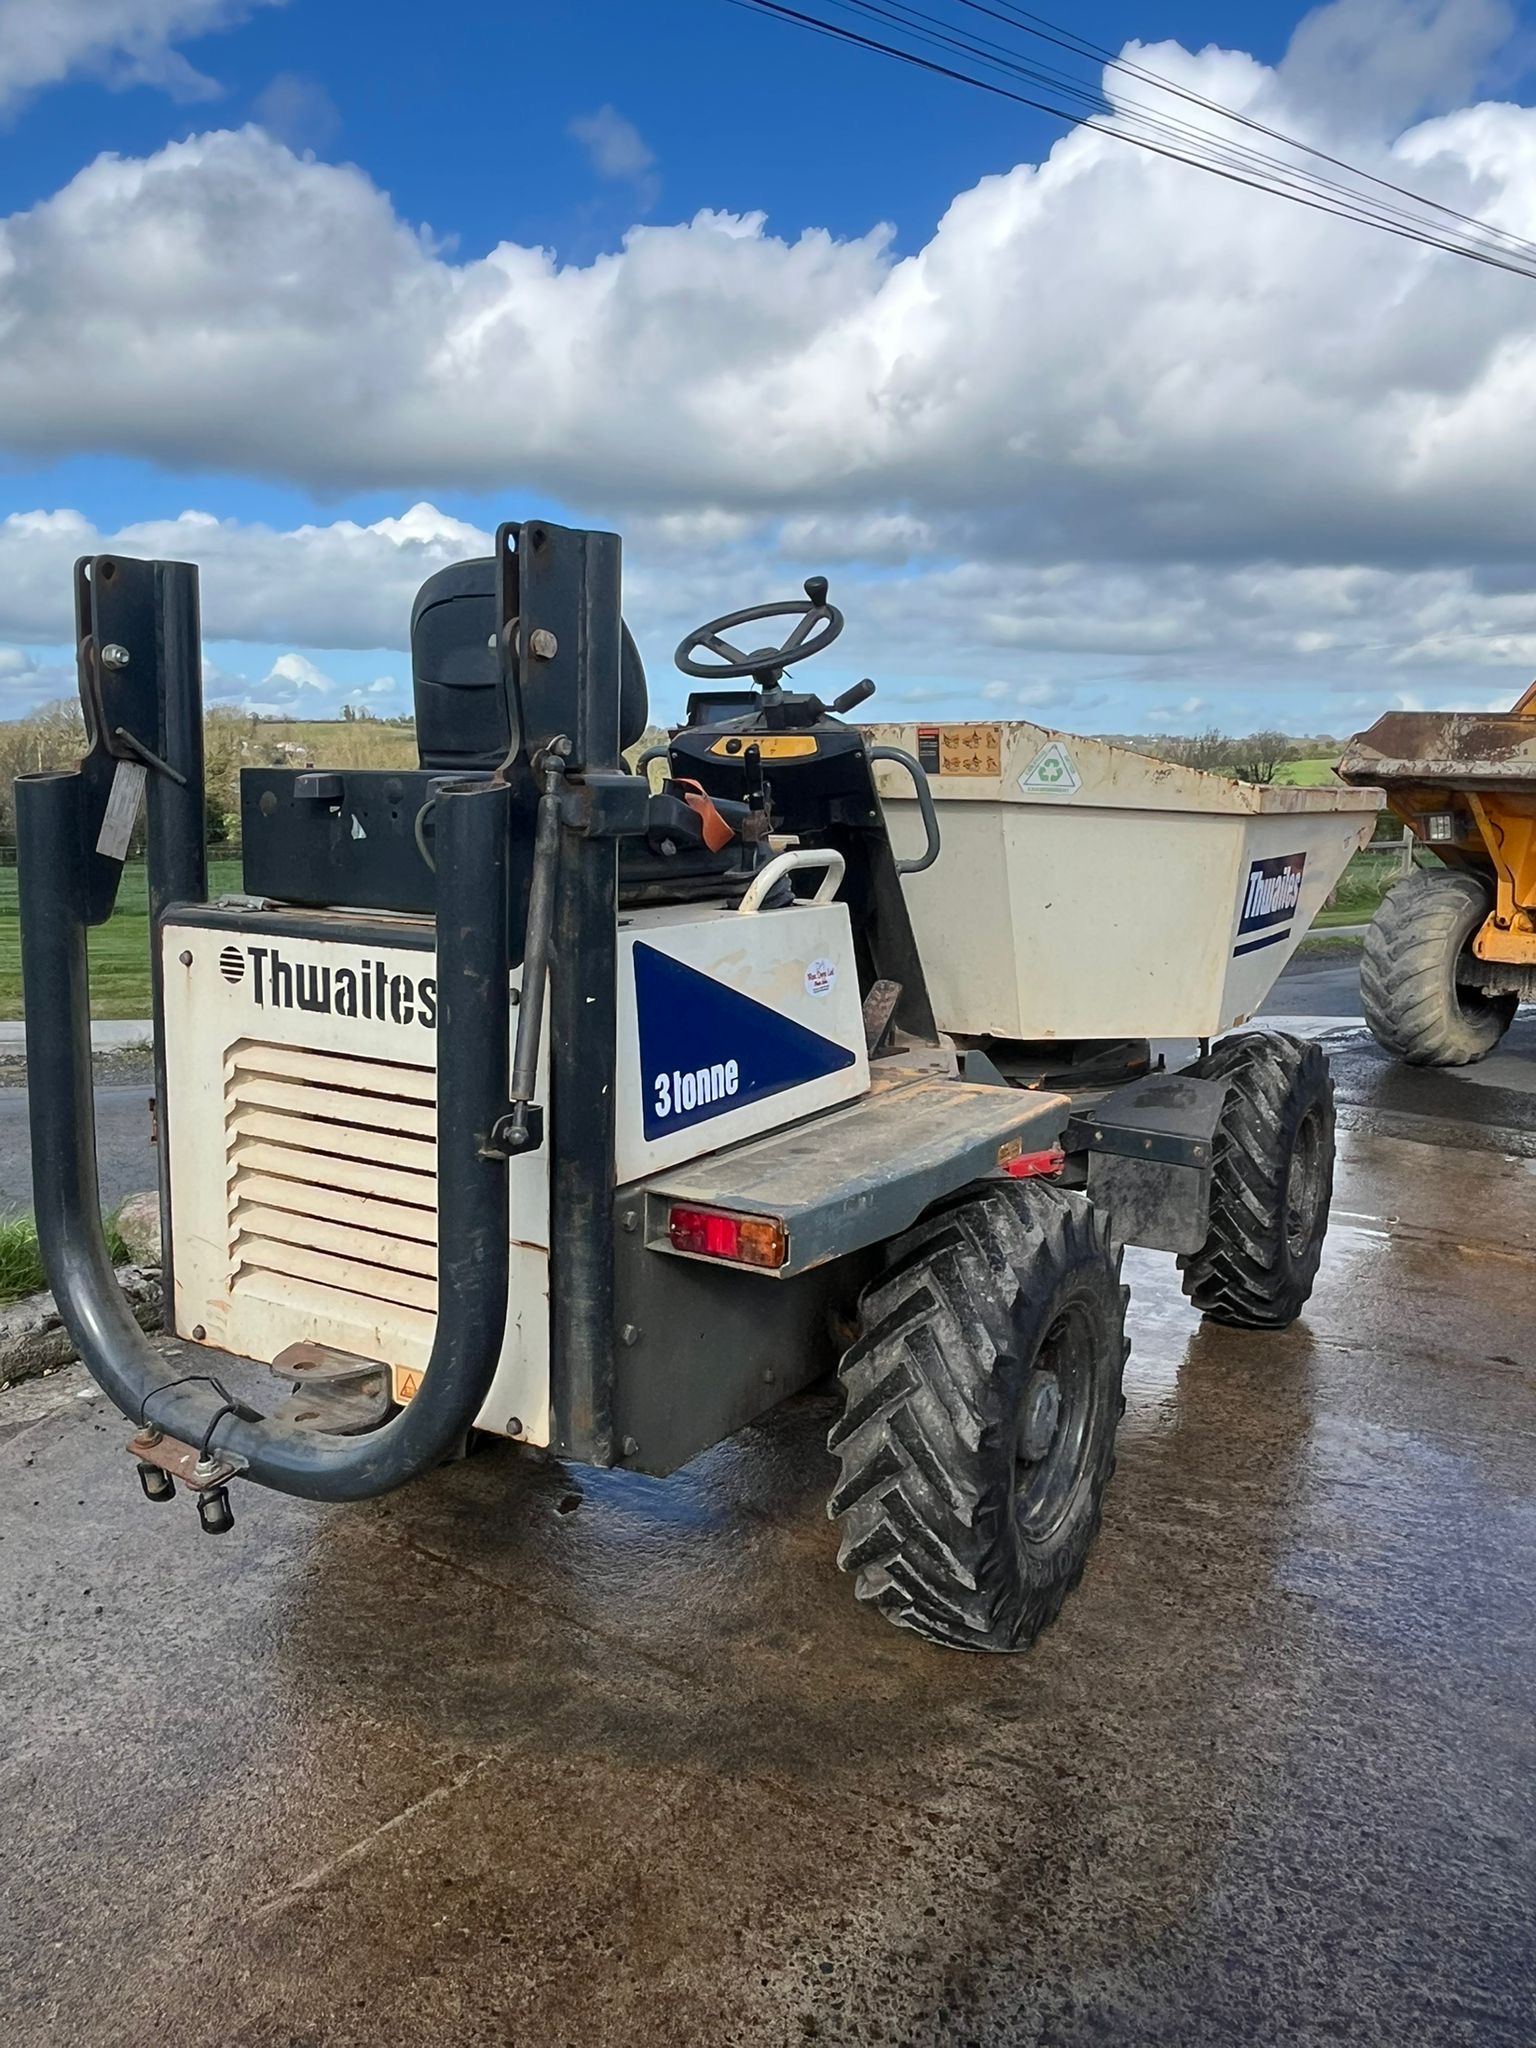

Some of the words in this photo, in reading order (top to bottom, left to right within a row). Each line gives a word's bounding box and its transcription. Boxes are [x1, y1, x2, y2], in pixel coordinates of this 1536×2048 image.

[1244, 866, 1301, 919] Thwaites
[247, 946, 437, 1029] Thwaites
[654, 1072, 672, 1118] 3
[673, 1059, 739, 1114] tonne
